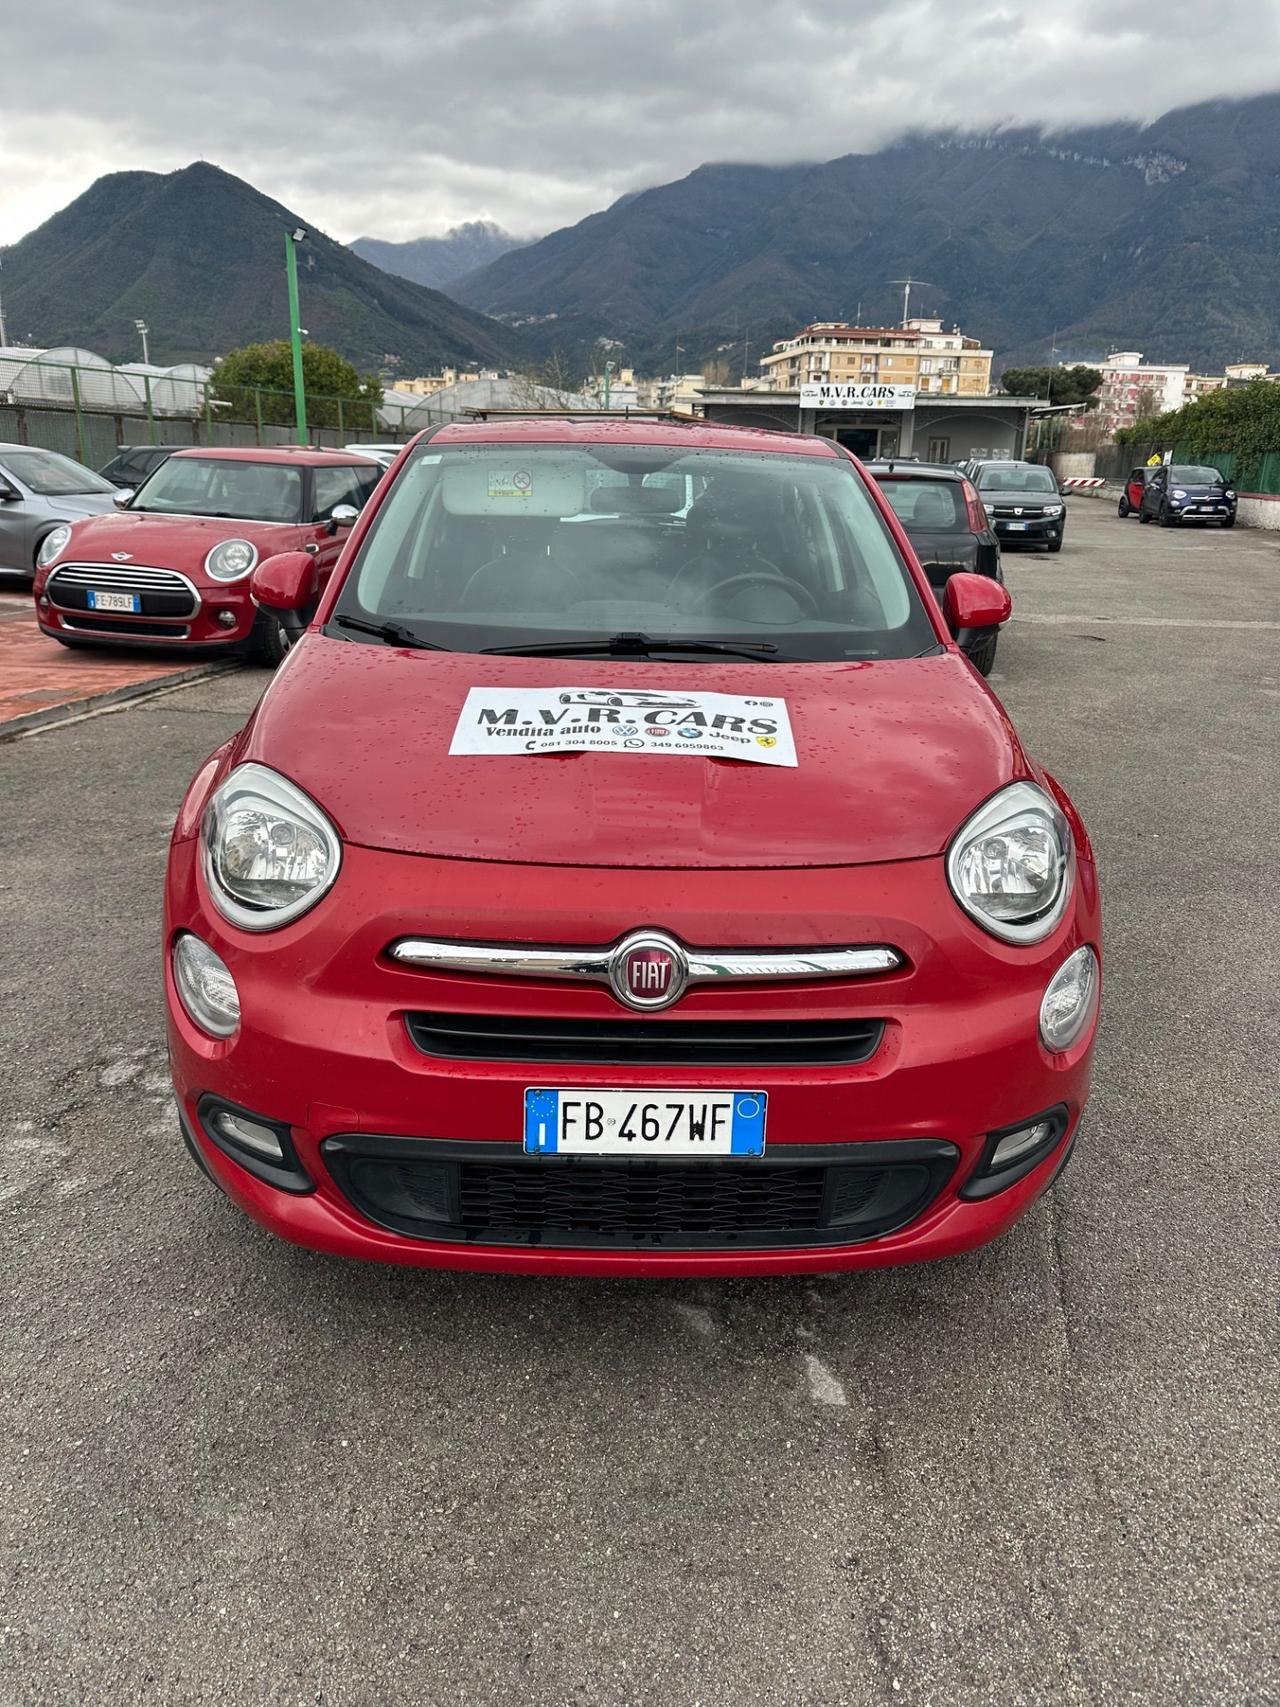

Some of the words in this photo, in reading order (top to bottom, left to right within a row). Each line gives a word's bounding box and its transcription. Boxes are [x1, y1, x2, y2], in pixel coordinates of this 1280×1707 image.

[486, 726, 554, 737] Vendita
[560, 724, 602, 735] auto
[709, 732, 751, 744] Jeep
[674, 742, 724, 751] 6959863
[632, 961, 668, 989] FIAT
